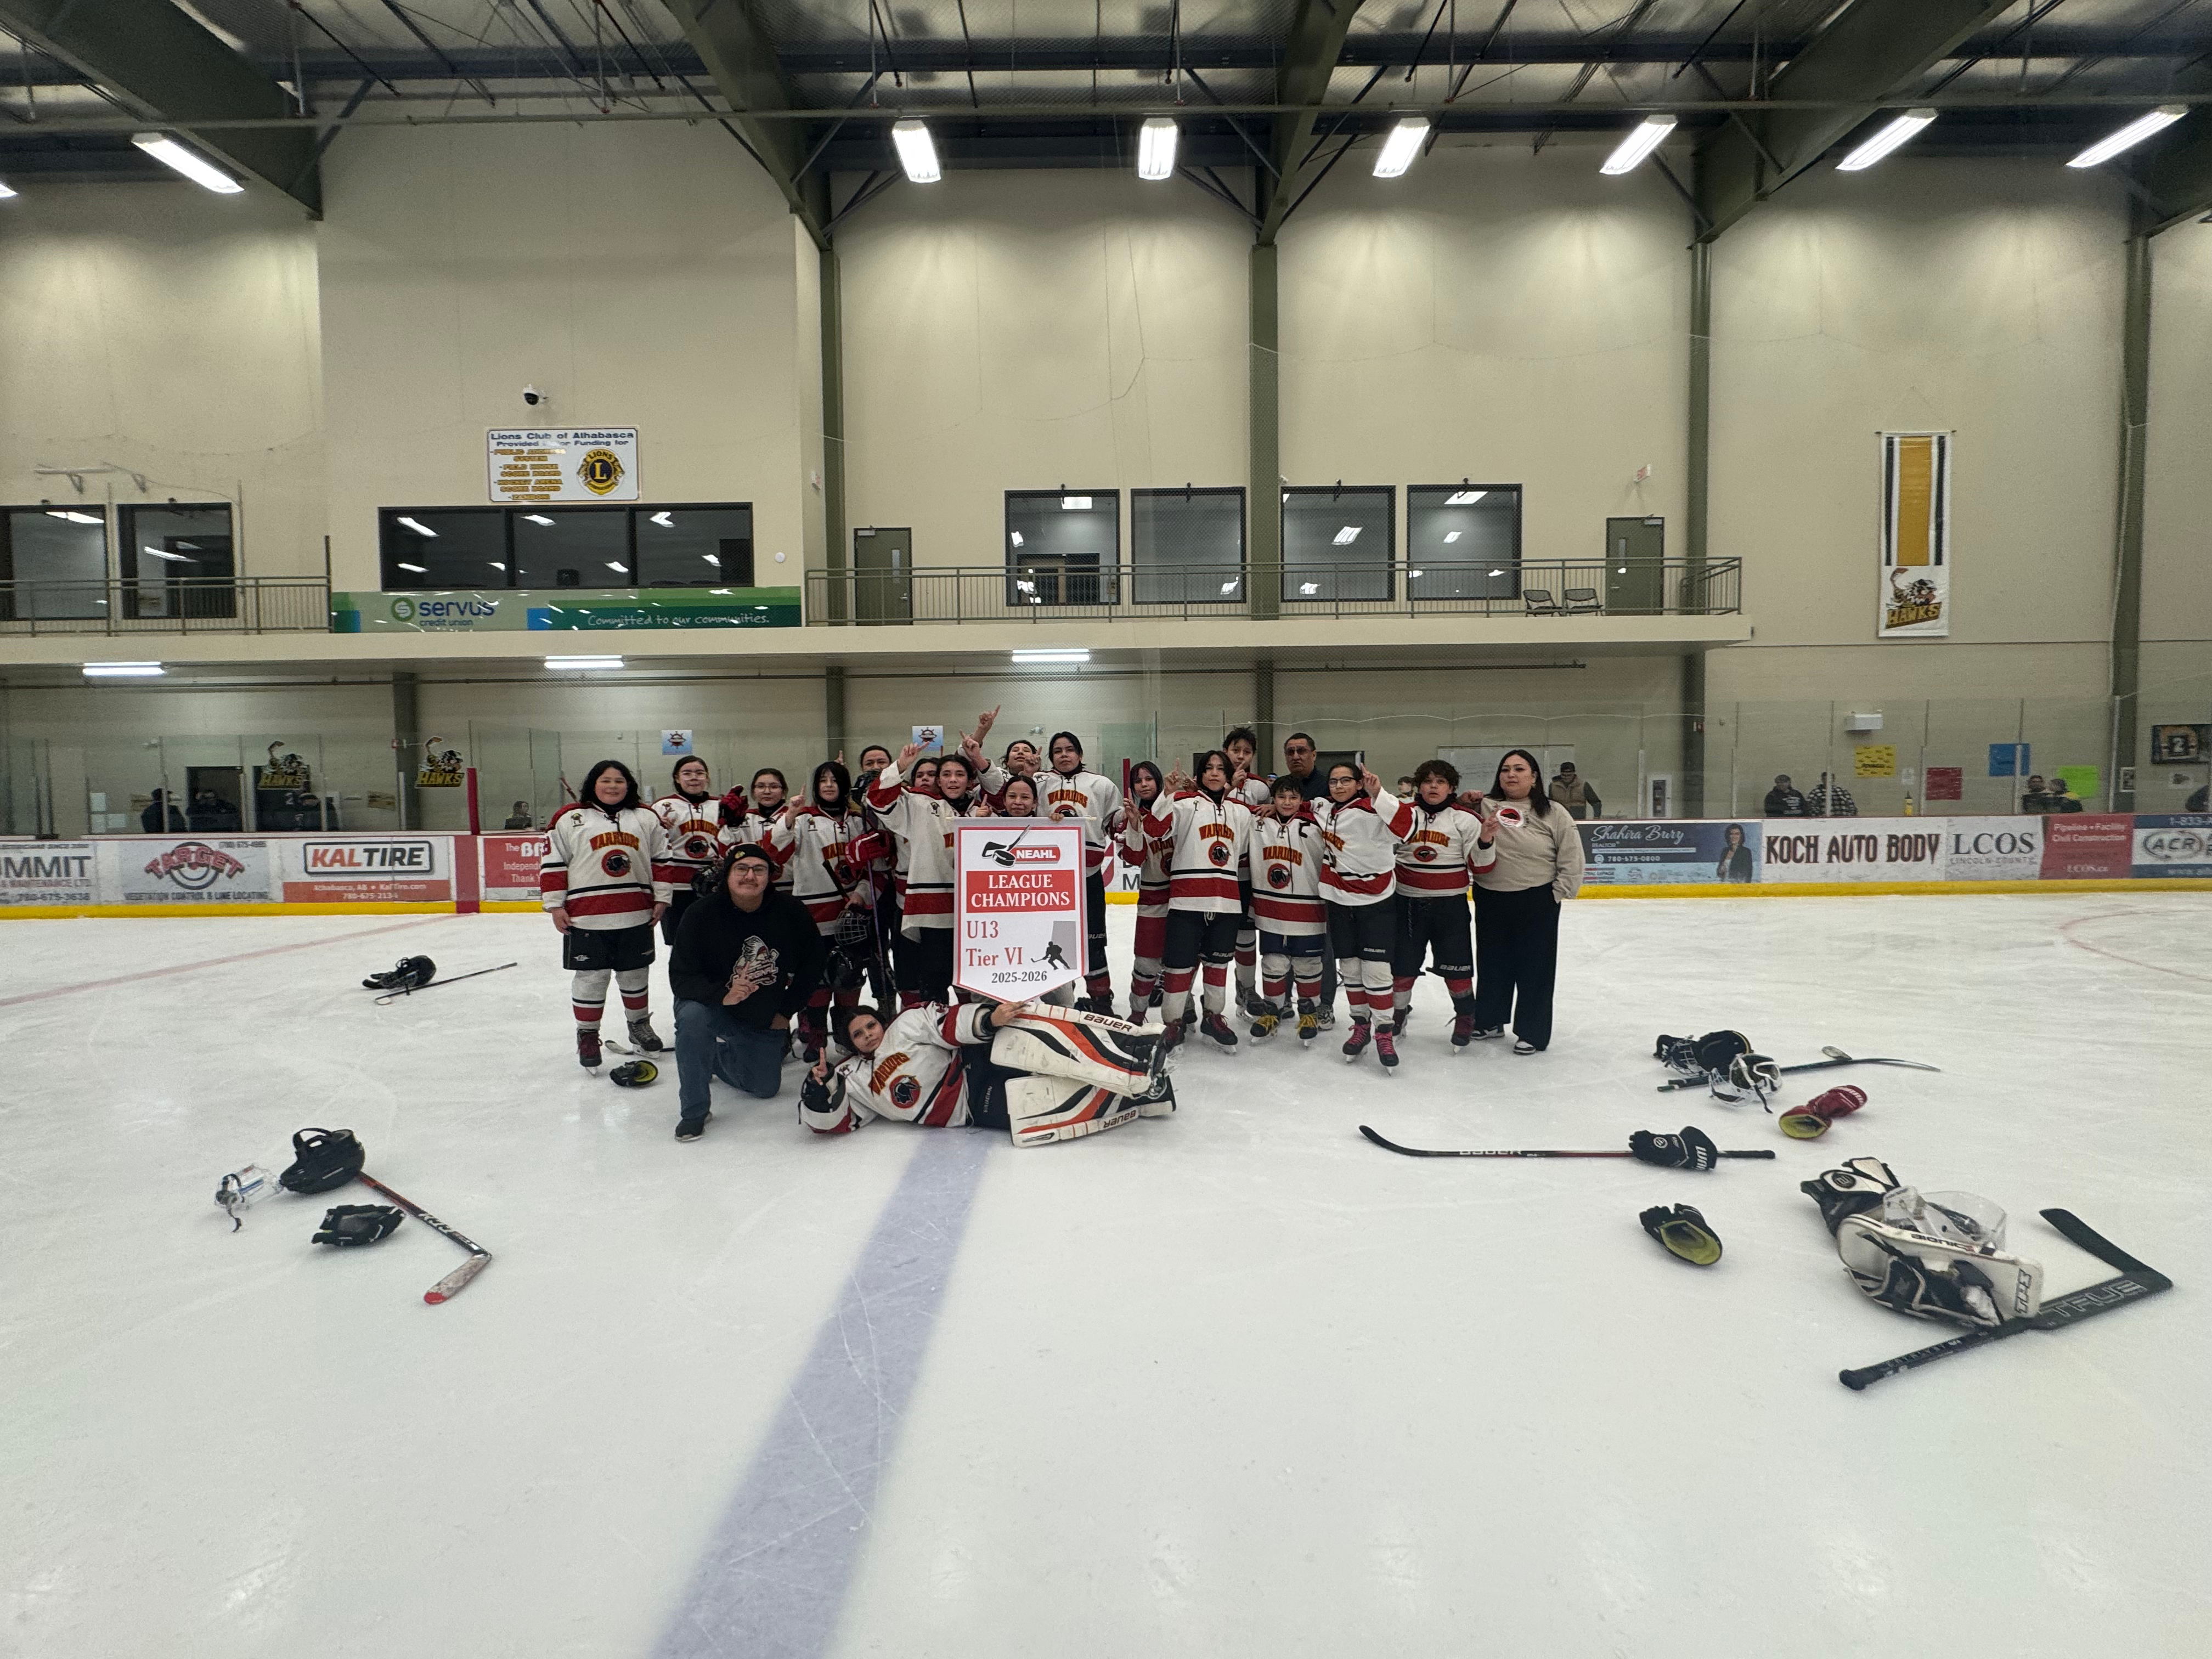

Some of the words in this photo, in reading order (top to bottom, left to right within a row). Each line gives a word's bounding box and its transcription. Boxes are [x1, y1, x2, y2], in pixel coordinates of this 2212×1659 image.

[588, 450, 613, 460] LIONS
[419, 601, 495, 616] servus
[588, 614, 653, 625] Committed
[656, 614, 668, 624] to
[673, 616, 690, 624] our
[419, 772, 464, 785] HAWKS
[1590, 825, 1642, 841] Shahira
[505, 843, 520, 852] The
[1765, 836, 1819, 864] KOCH
[1827, 834, 1878, 863] AUTO
[1886, 833, 1940, 865] BODY
[1950, 832, 2034, 854] LCOS
[1017, 849, 1056, 859] NEAHL
[0, 856, 92, 878] MMIT
[144, 847, 245, 879] TARGET
[511, 874, 534, 882] Thank
[989, 874, 1053, 889] LEAGUE
[971, 891, 1070, 907] CHAMPIONS
[967, 921, 998, 939] U13
[966, 949, 998, 967] Tier
[1005, 947, 1023, 965] VI
[991, 971, 1047, 983] 2025-2026
[1084, 1014, 1132, 1032] BAUER
[1103, 1109, 1136, 1128] BAUER
[2037, 1279, 2148, 1318] TRUE
